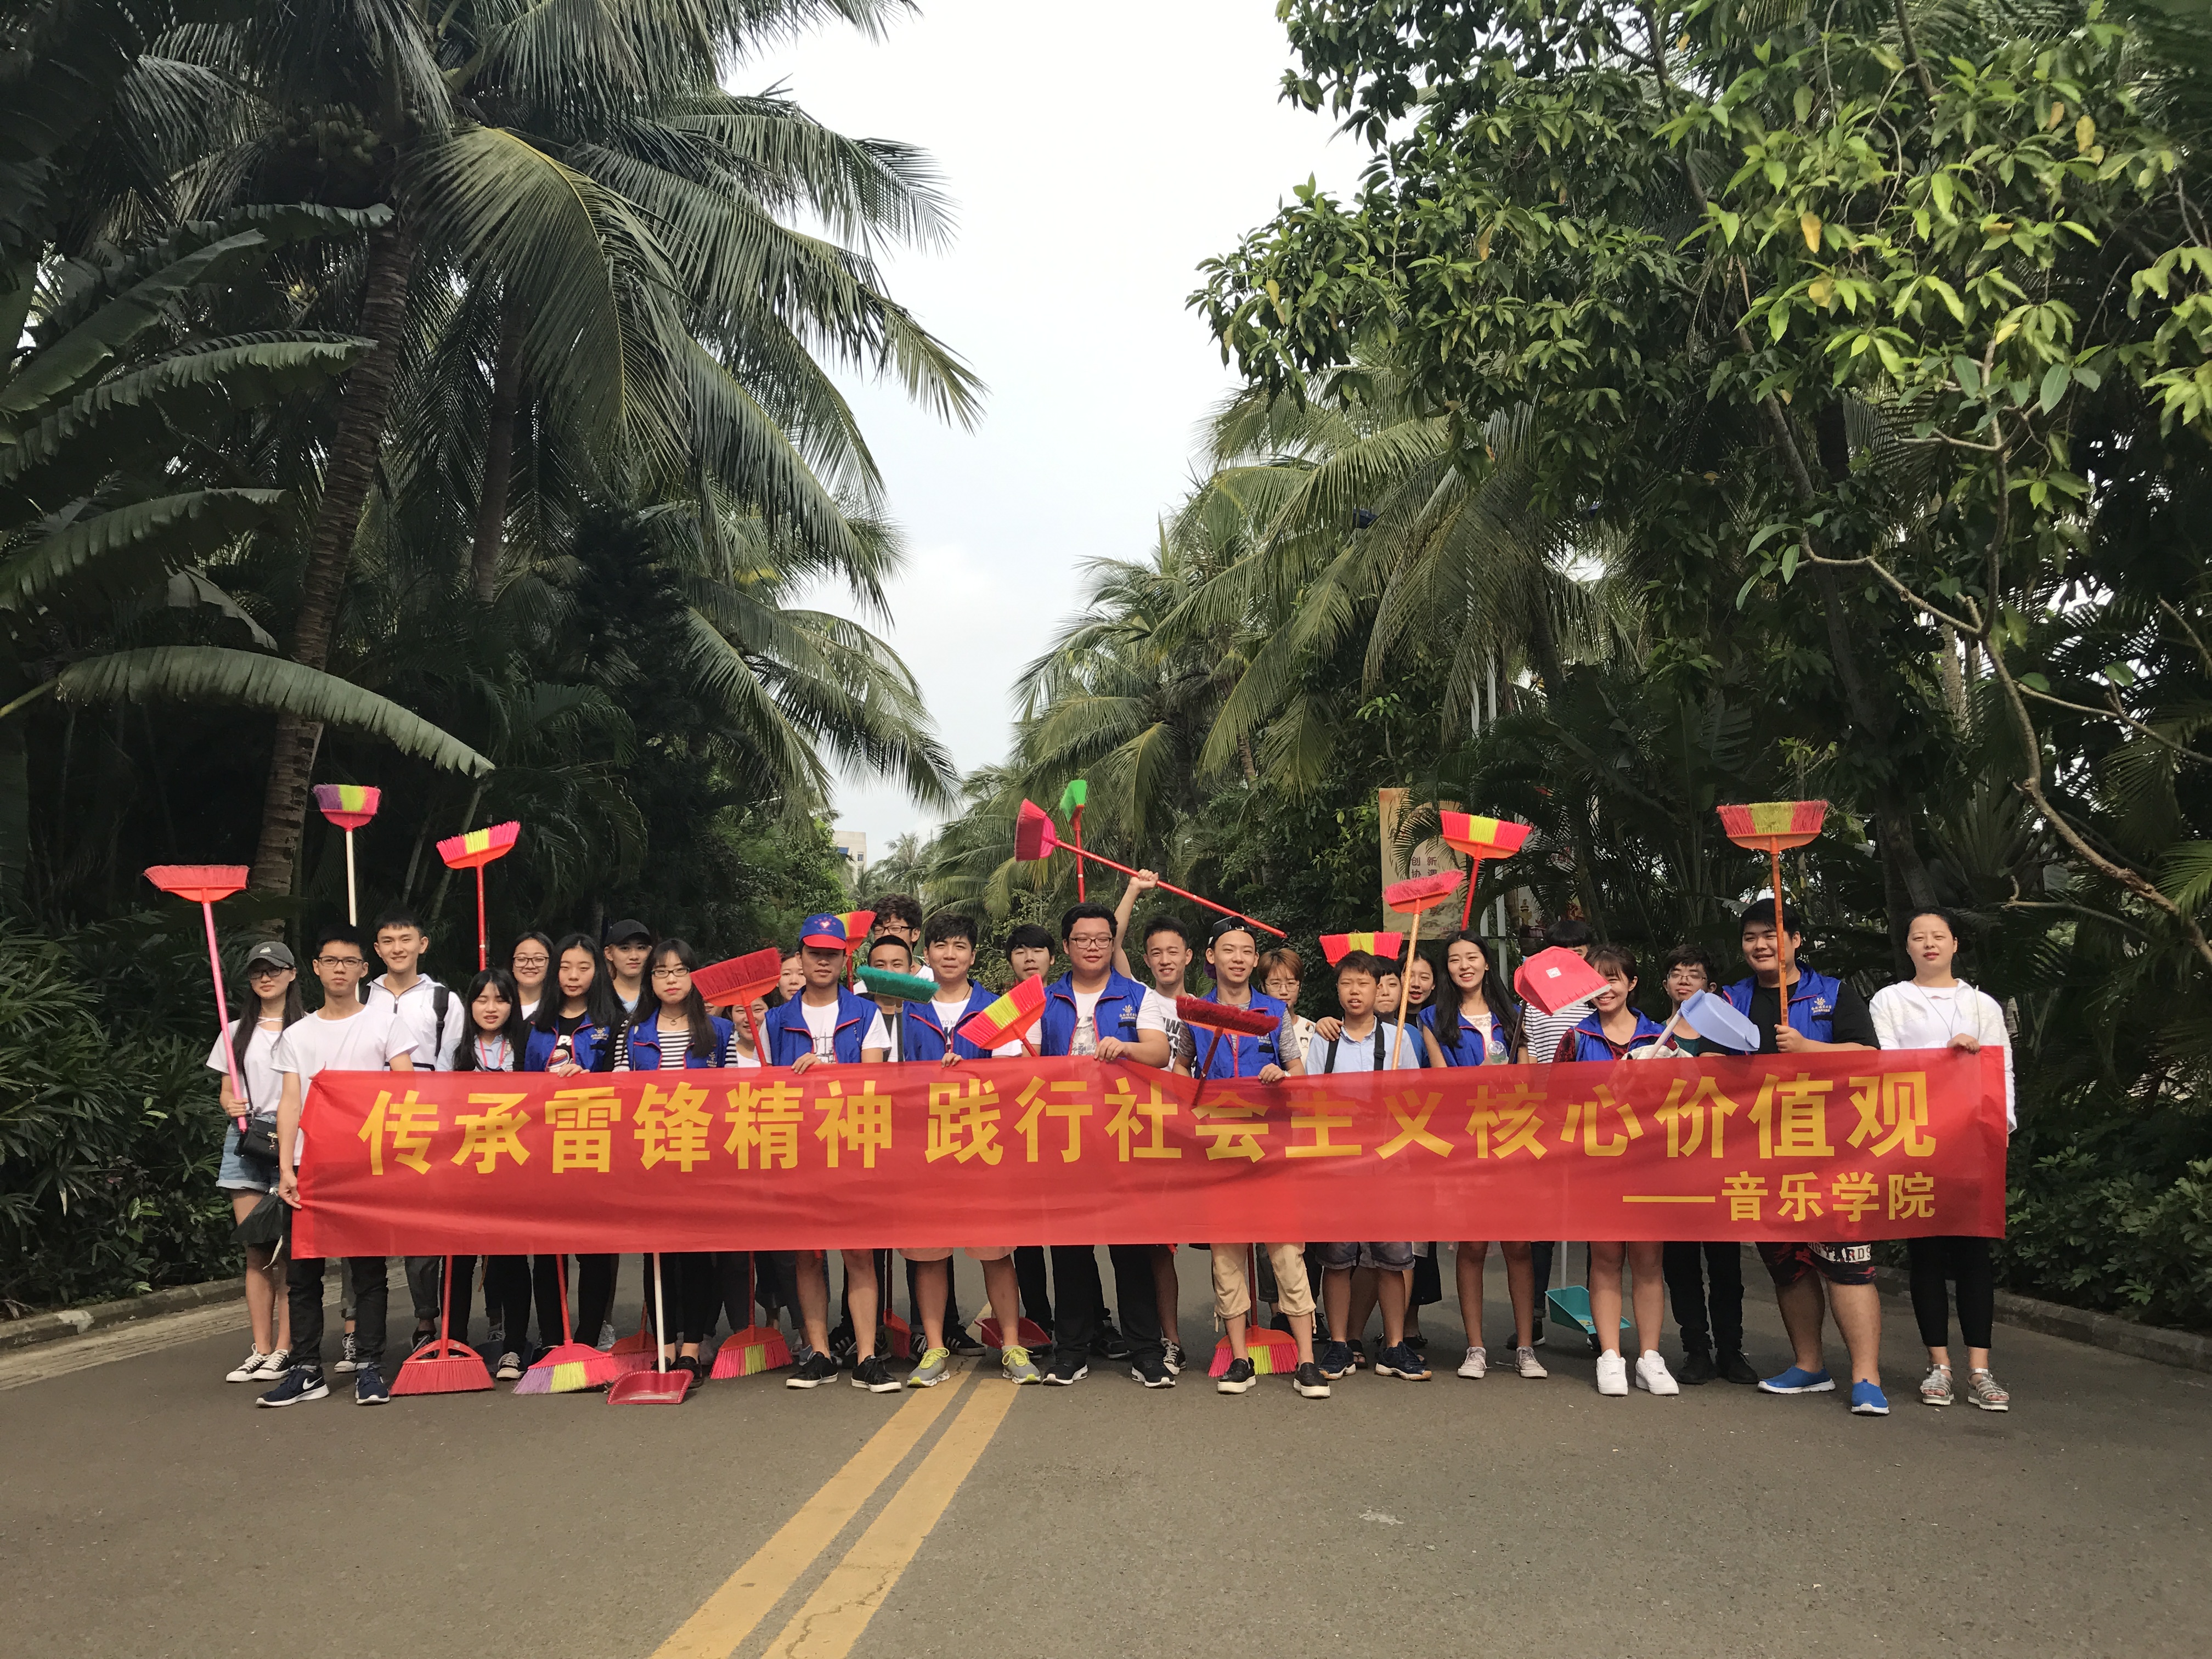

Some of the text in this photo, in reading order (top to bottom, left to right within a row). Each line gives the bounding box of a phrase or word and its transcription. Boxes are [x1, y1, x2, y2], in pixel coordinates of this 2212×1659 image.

[1411, 856, 1437, 866] 创新
[357, 1071, 1937, 1175] 传承雷锋精神 践行社会主义核心价值观
